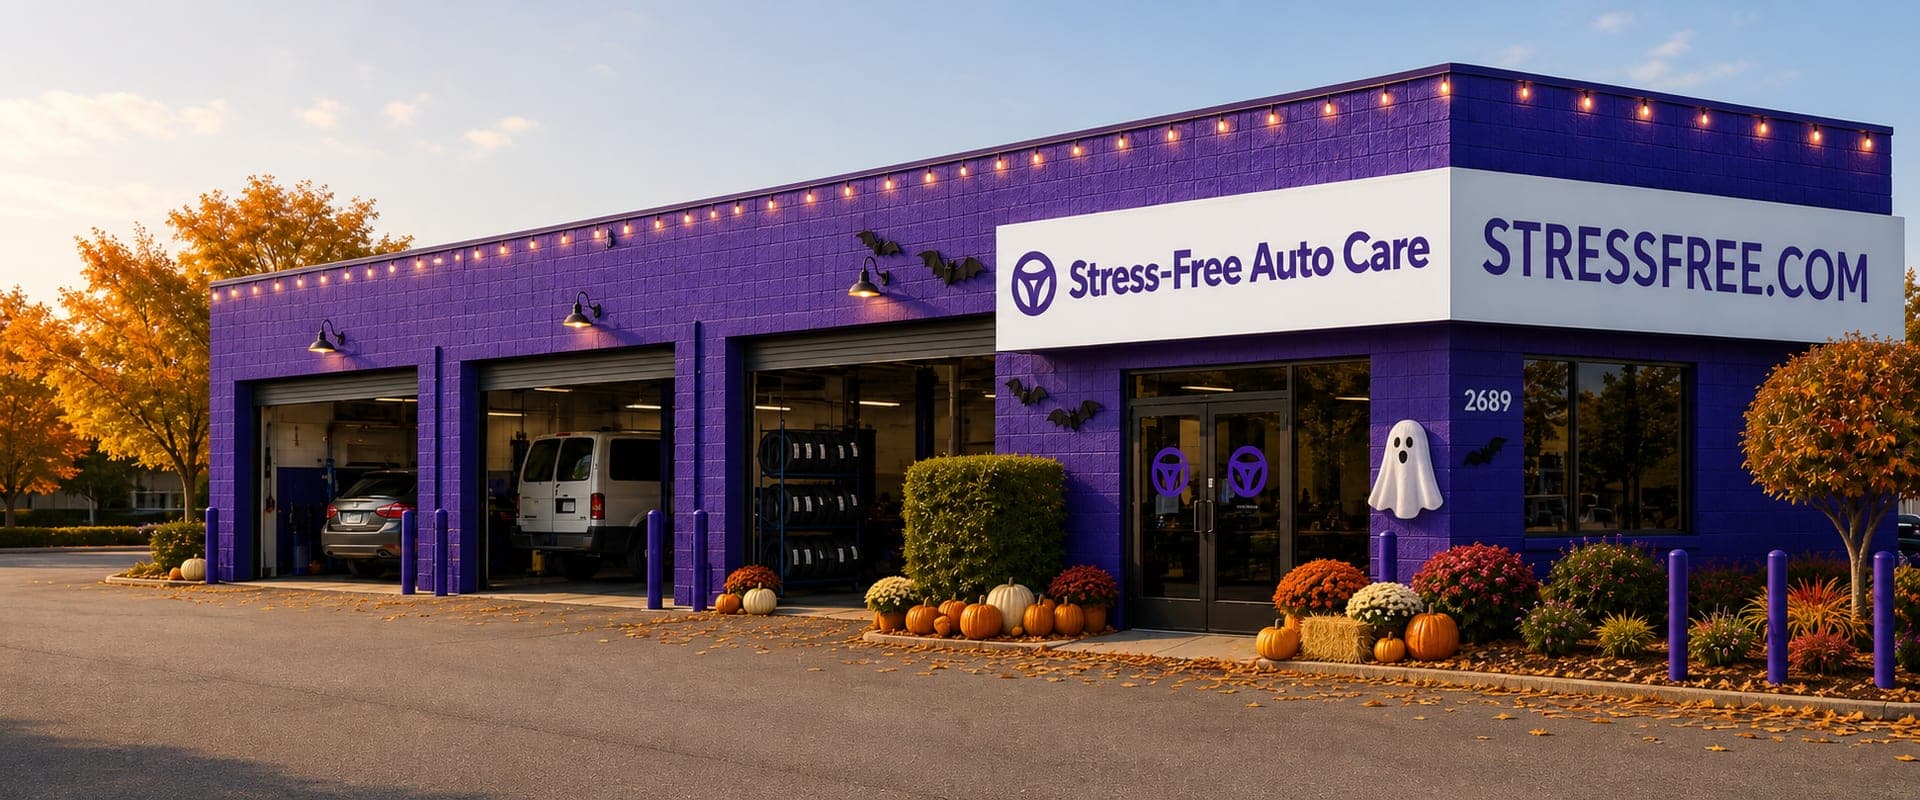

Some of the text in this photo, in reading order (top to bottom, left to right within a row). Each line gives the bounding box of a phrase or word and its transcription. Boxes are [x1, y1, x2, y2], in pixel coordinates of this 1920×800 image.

[1069, 230, 1430, 299] Stress-Free Auto Care
[1482, 217, 1869, 304] STRESSFREE.COM
[1464, 389, 1512, 412] 2689
